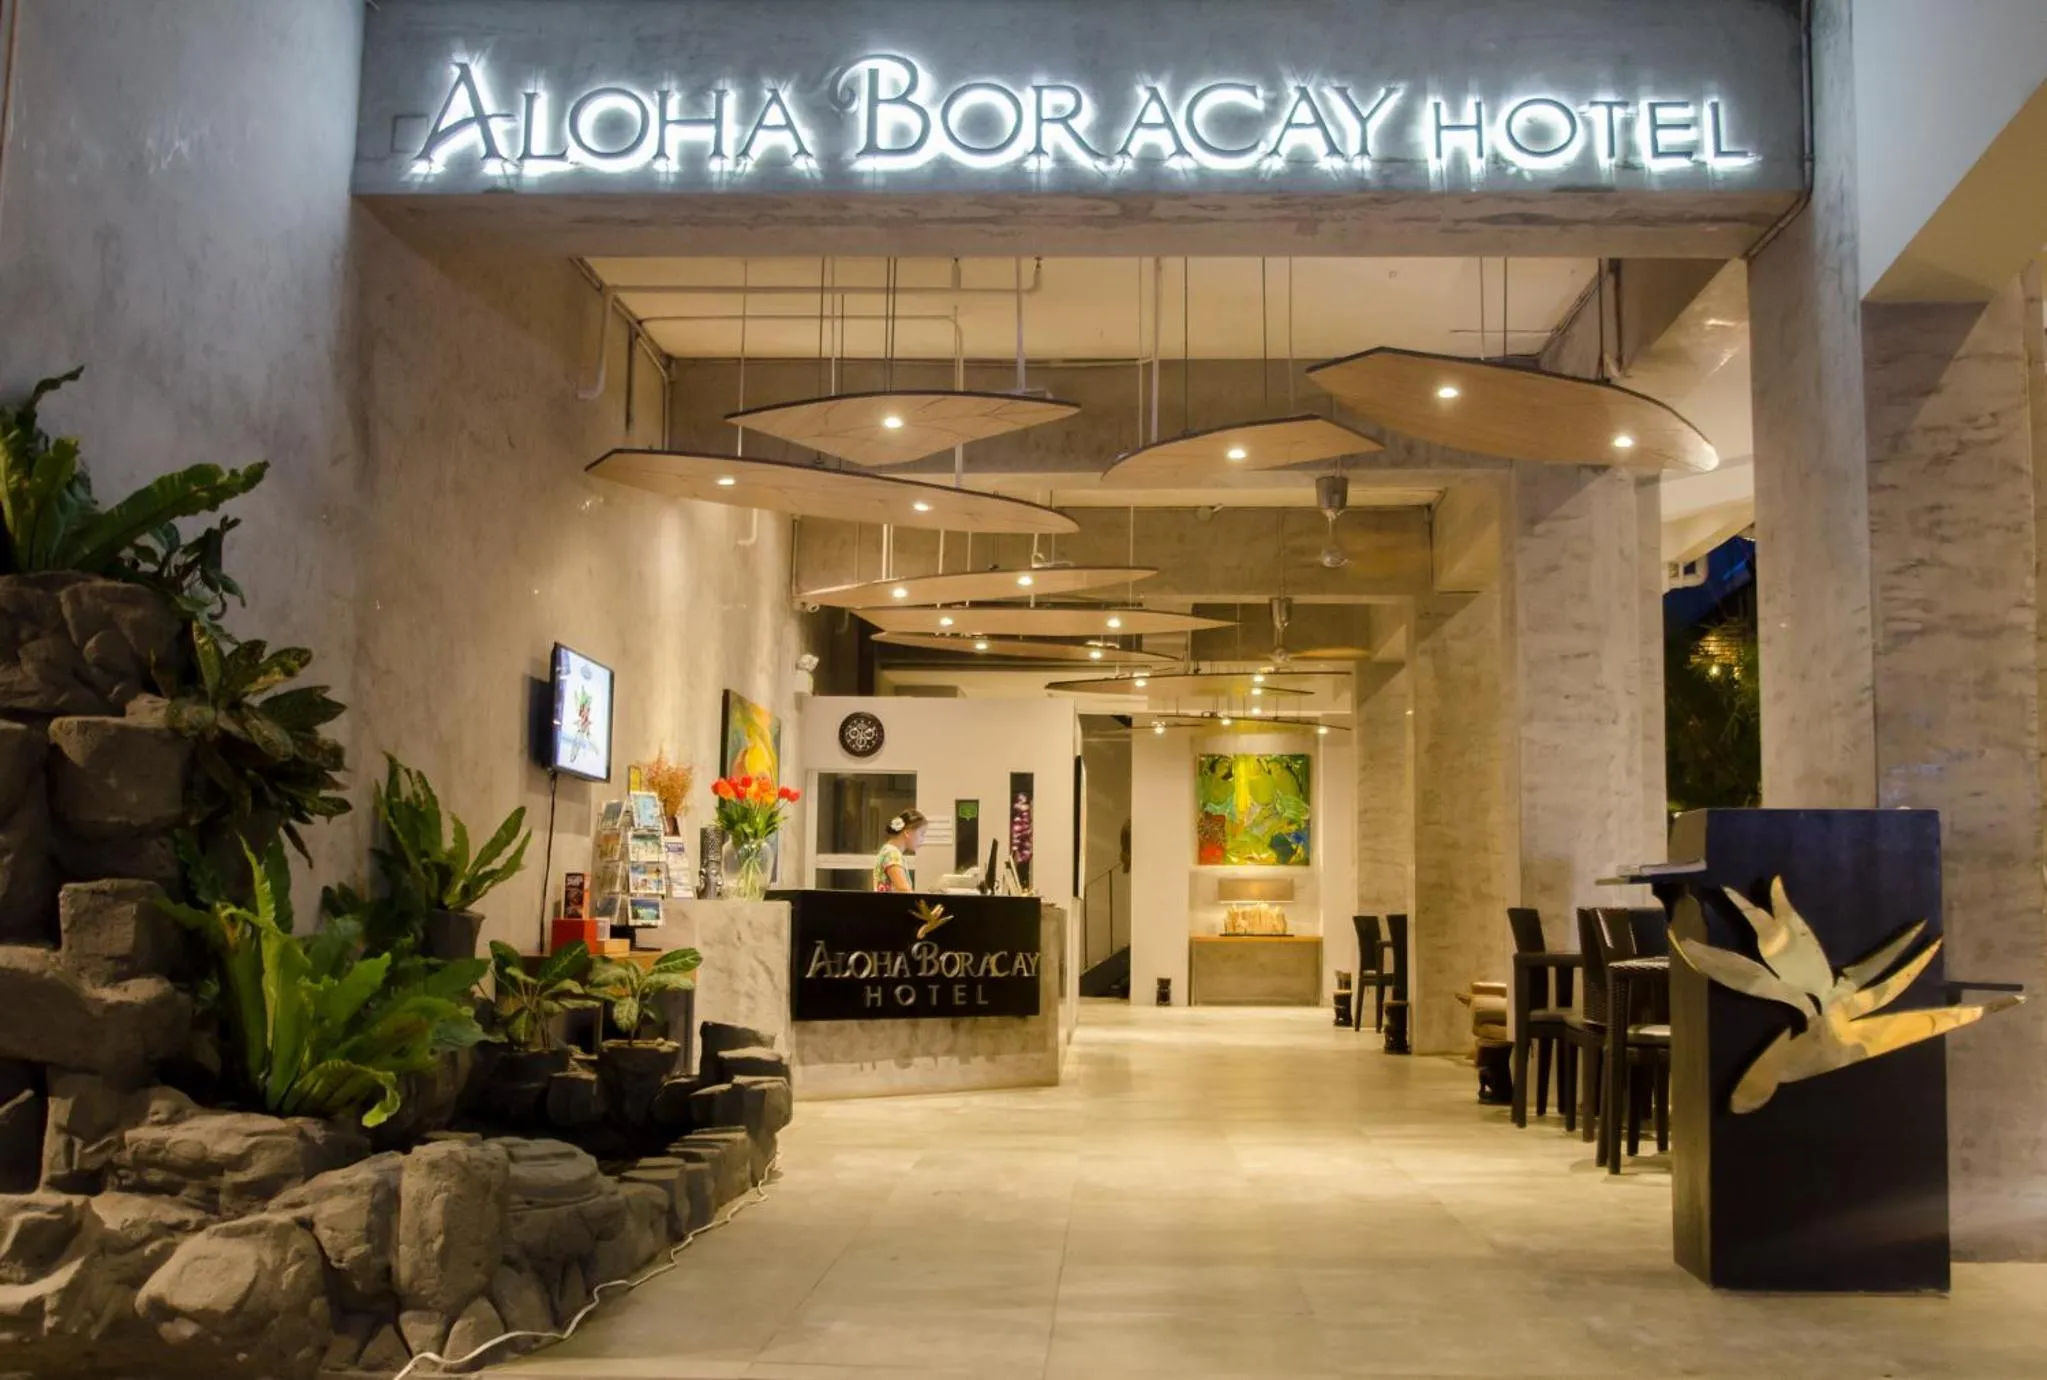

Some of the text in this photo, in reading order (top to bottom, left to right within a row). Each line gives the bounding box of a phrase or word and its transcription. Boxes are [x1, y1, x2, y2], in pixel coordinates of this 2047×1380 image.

[413, 53, 1750, 161] ALOHA BORACAY HOTEL
[805, 940, 1041, 979] ALOHA BORACAY
[864, 985, 989, 1008] HOTEL
